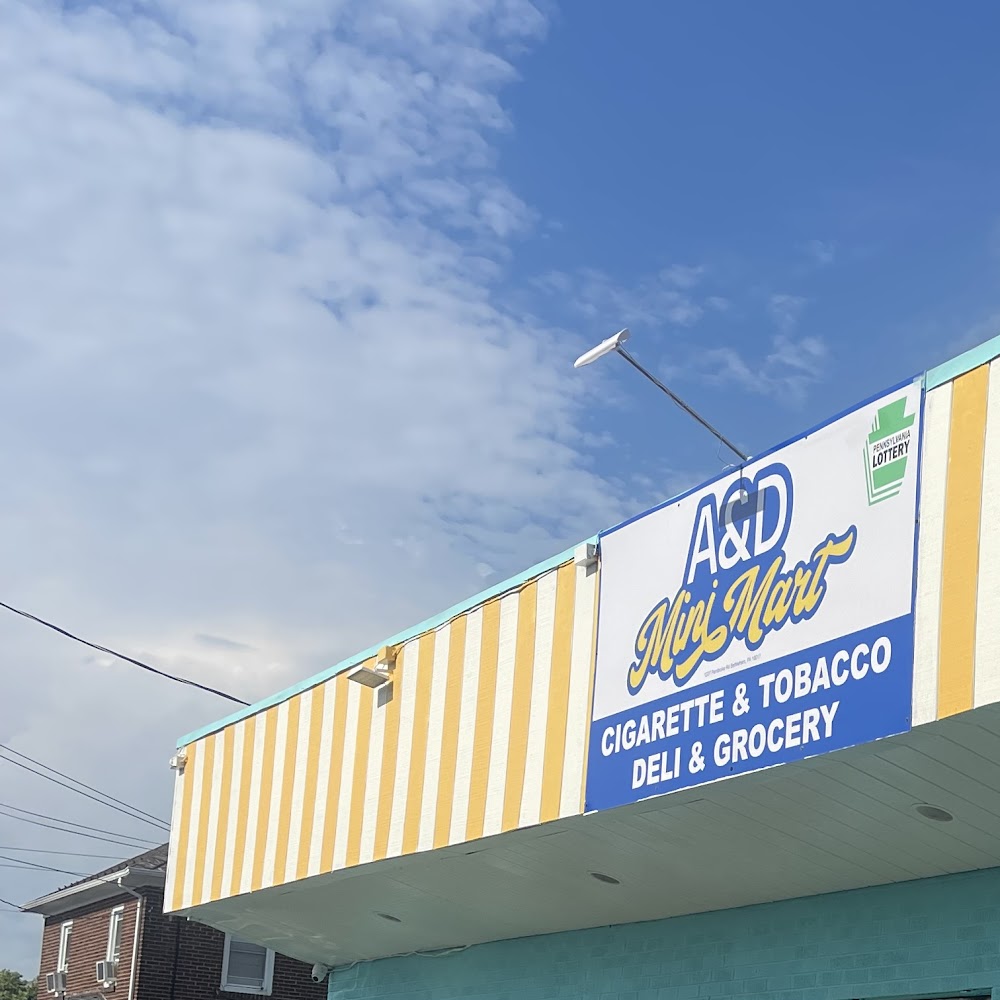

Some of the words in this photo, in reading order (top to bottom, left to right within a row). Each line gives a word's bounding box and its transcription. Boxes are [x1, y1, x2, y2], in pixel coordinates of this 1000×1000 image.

[873, 440, 910, 468] LOTTERY
[687, 471, 789, 584] A&D
[628, 581, 729, 688] Mini
[724, 530, 855, 642] Mart
[601, 690, 725, 757] CIGARETTE
[732, 683, 750, 717] &
[758, 636, 892, 708] TOBACCO
[632, 748, 681, 789] DELI
[688, 743, 706, 774] &
[714, 701, 840, 768] GROCERY
